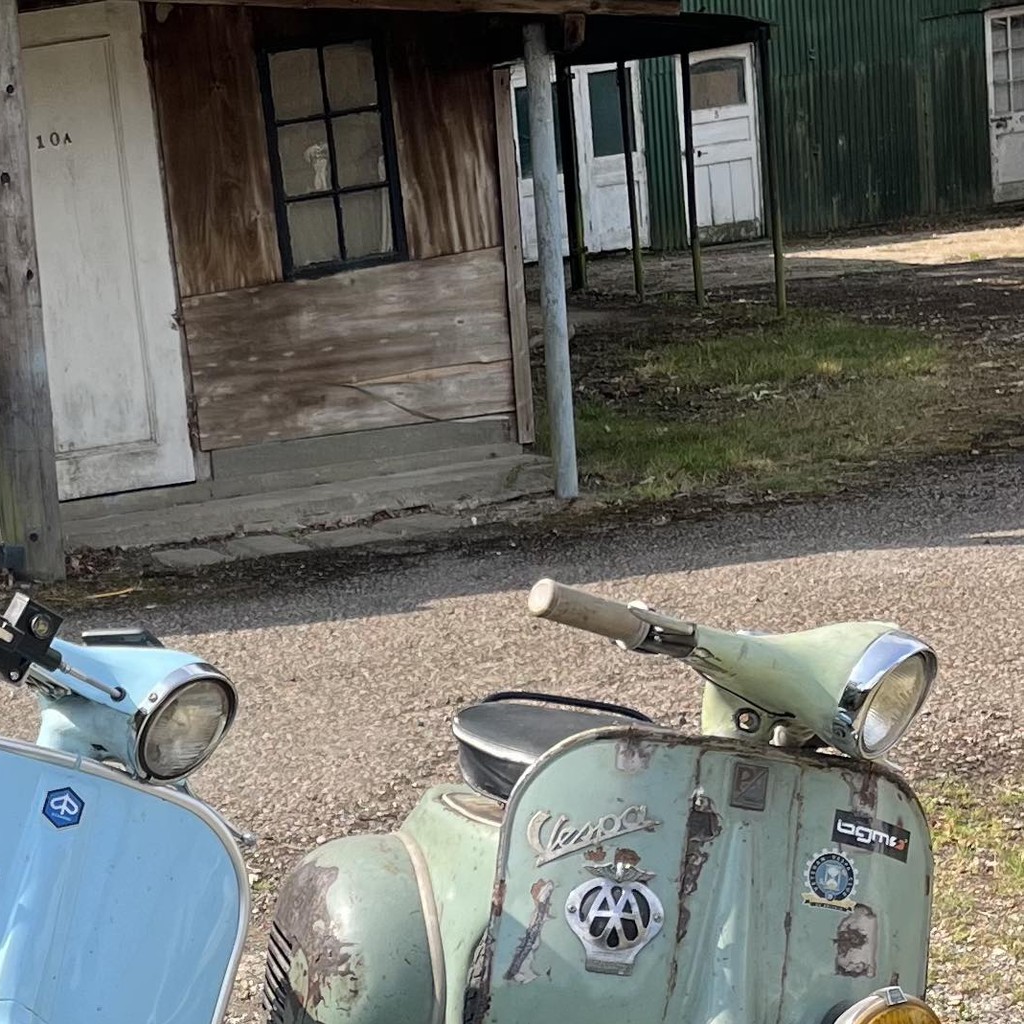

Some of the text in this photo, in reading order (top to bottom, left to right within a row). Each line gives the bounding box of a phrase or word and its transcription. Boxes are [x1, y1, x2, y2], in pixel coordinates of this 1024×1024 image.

[36, 131, 72, 149] 10A
[527, 805, 660, 867] Vespa
[584, 880, 648, 944] AA
